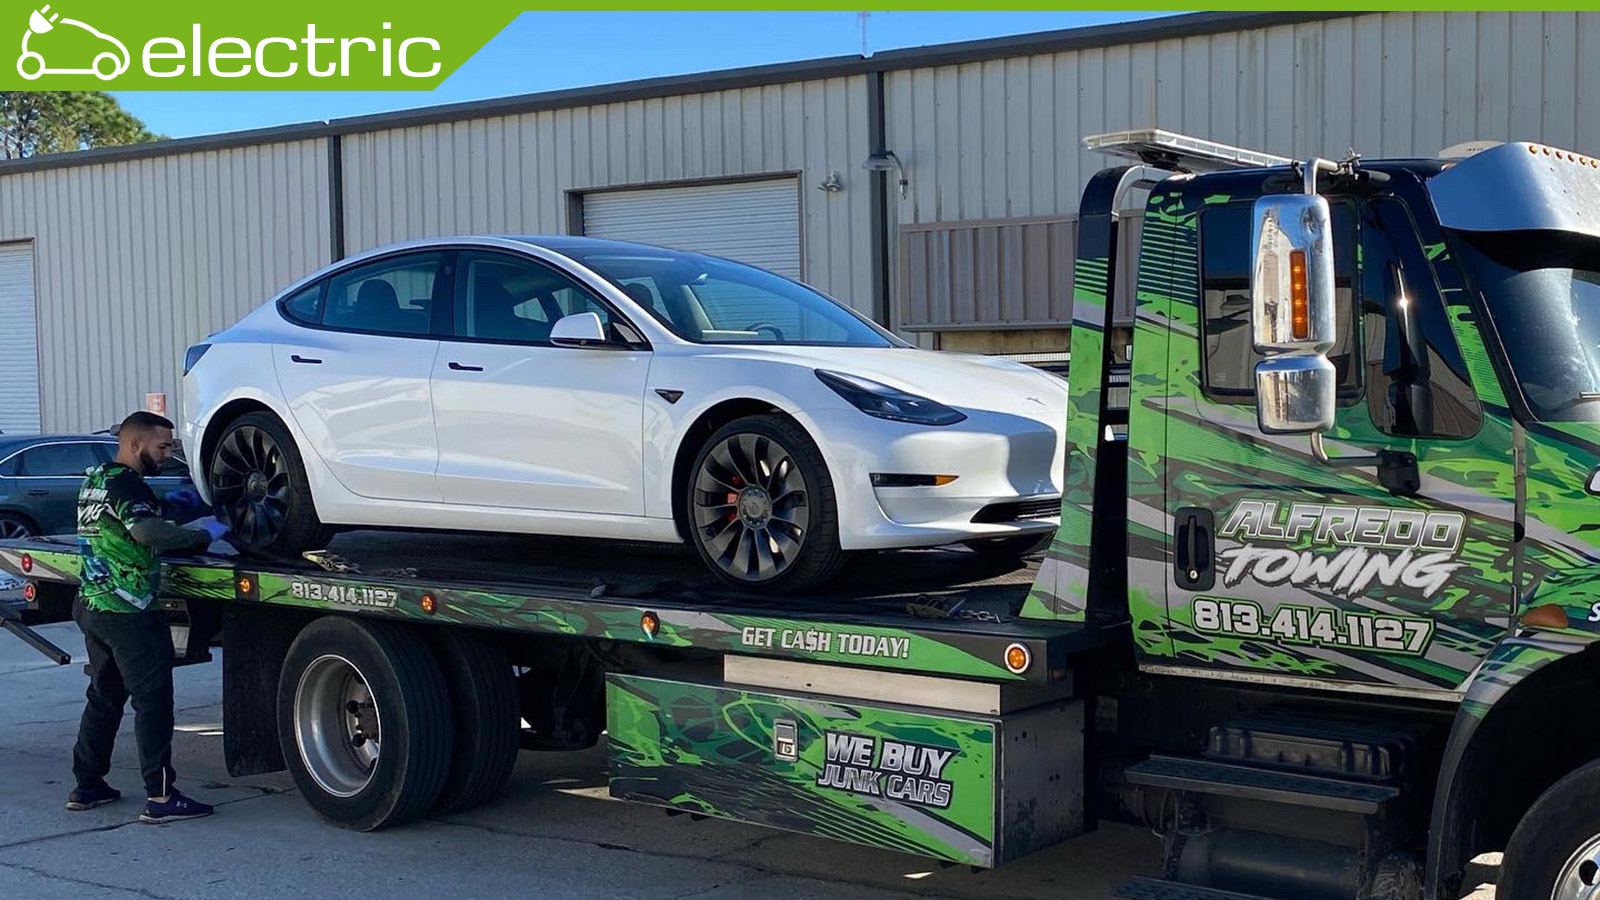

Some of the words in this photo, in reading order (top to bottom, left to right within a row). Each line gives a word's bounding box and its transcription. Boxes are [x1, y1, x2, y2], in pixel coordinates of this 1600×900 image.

[1219, 500, 1466, 550] ALFREDO
[1218, 543, 1465, 597] TOWING
[291, 581, 398, 608] 813.414.1127
[742, 626, 776, 648] GET
[838, 633, 910, 658] TODAY!
[1193, 600, 1433, 653] 813.414.1127
[825, 732, 875, 767] WE
[880, 741, 951, 779] BUY
[817, 763, 882, 795] JUNK
[886, 775, 951, 807] CARS
